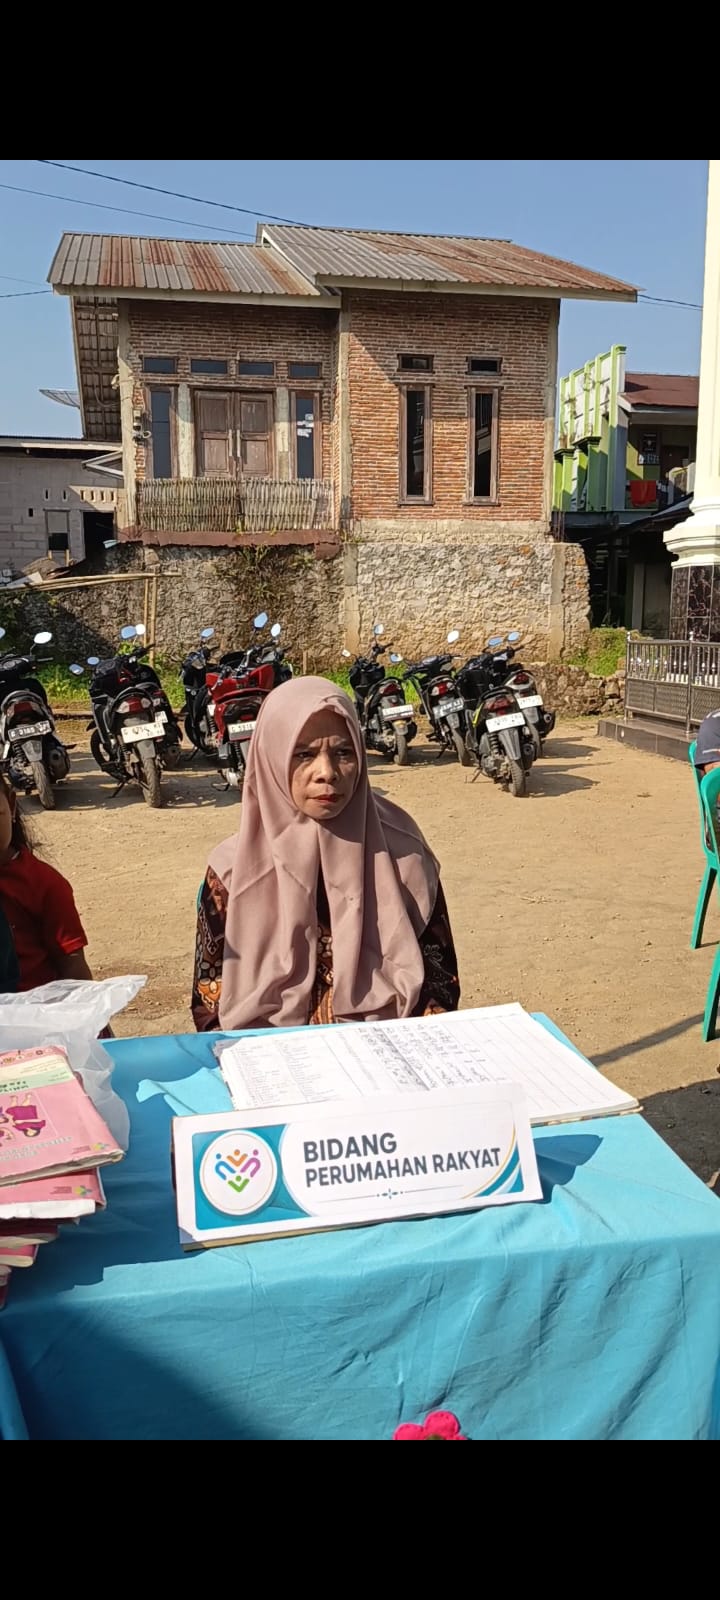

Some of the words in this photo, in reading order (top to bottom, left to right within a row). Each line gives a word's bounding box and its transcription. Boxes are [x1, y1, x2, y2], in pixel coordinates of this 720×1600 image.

[303, 1132, 397, 1163] BIDANG
[305, 1155, 428, 1188] PERUMAHAN
[432, 1147, 501, 1173] RAKYAT
